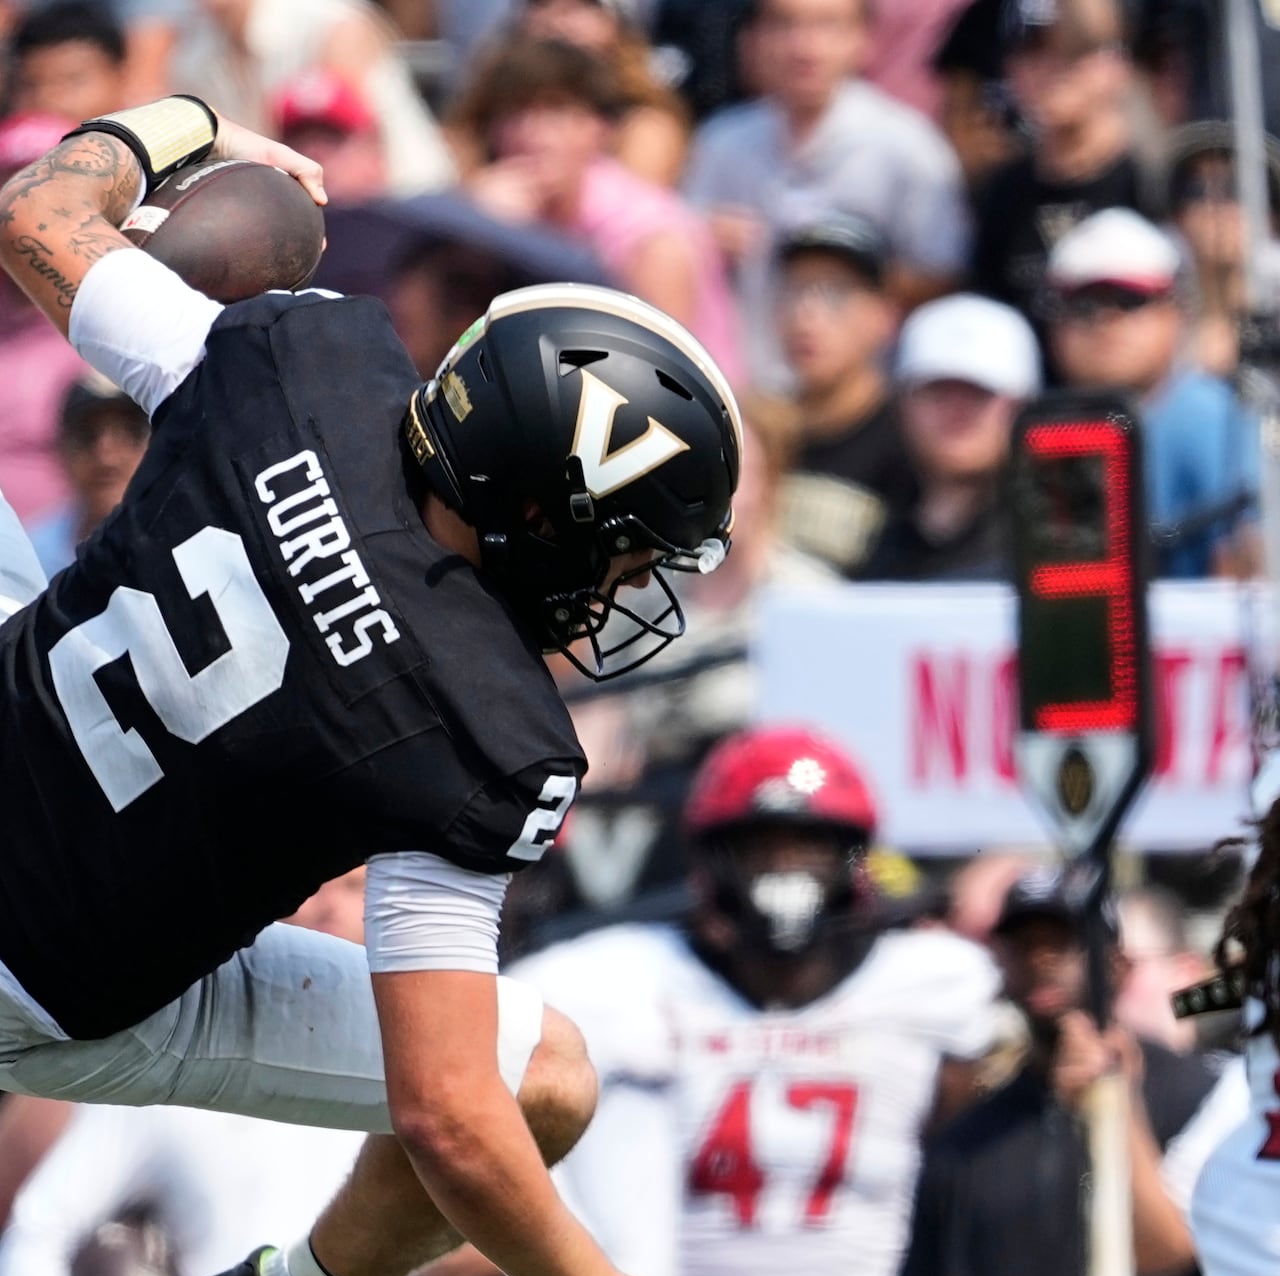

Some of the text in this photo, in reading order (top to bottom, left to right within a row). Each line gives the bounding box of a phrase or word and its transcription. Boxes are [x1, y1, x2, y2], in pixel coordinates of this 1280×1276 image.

[571, 367, 691, 500] V
[255, 450, 401, 667] CURTIS
[1025, 422, 1136, 735] 3
[48, 525, 290, 813] 2
[506, 774, 577, 861] 2
[688, 1080, 860, 1230] 47
